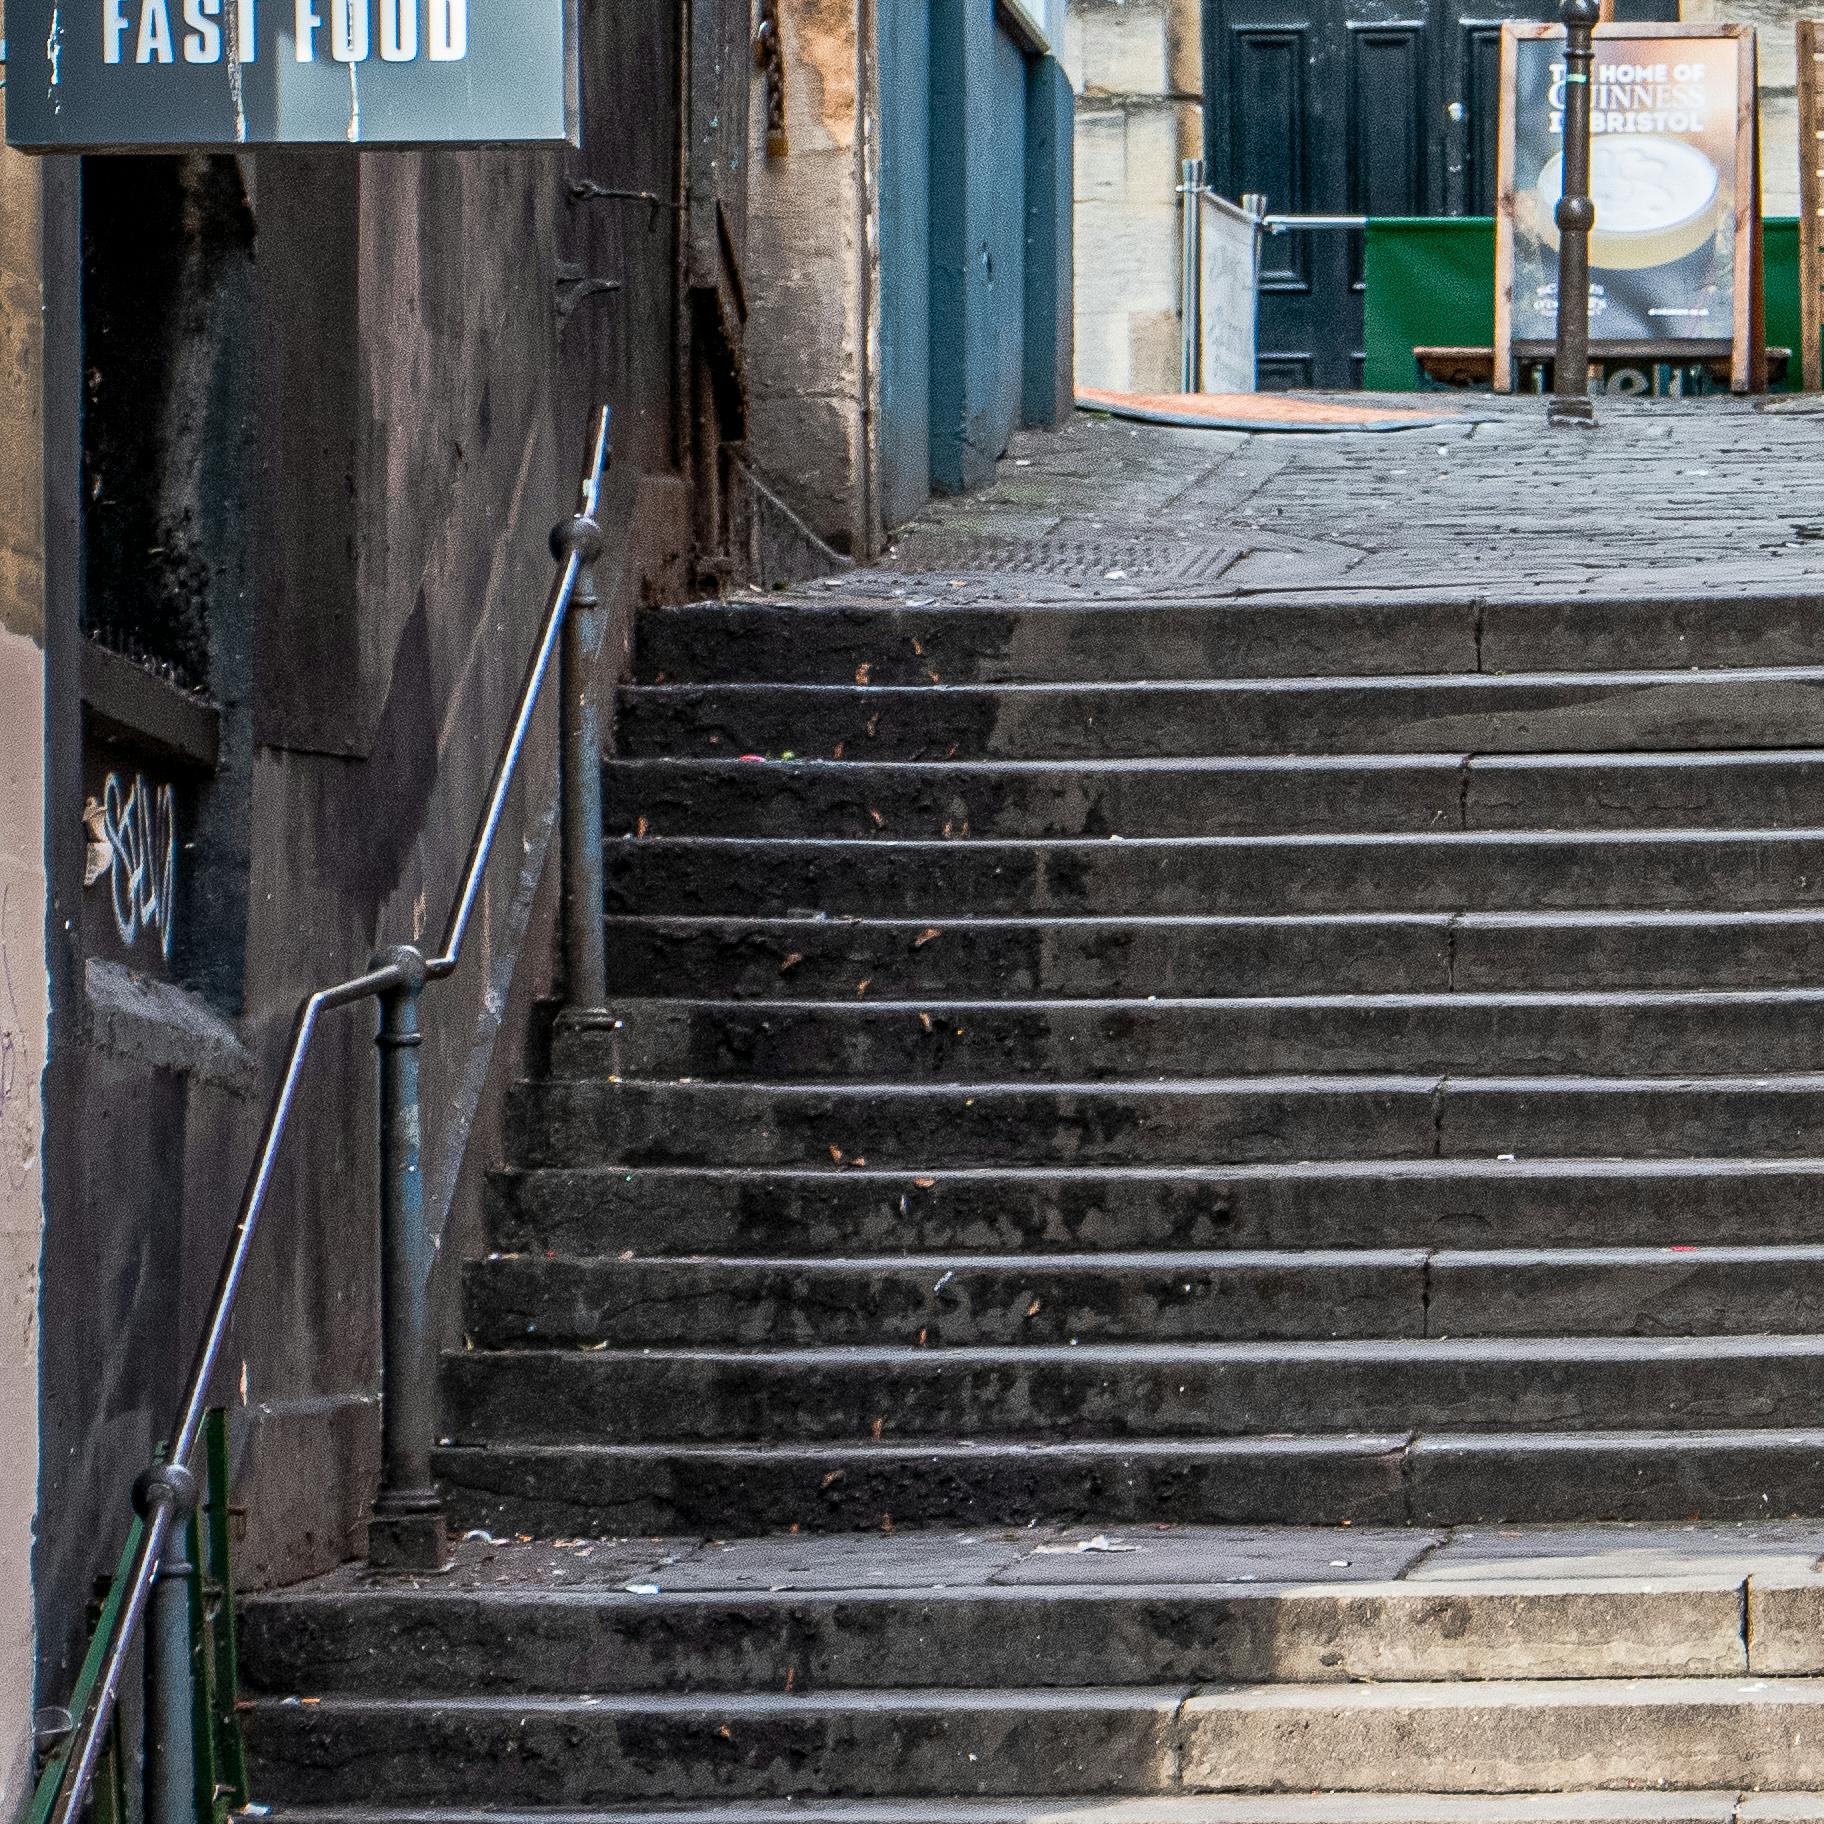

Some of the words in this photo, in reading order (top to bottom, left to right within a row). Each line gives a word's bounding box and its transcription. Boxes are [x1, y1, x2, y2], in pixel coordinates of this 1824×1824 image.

[1599, 64, 1667, 83] HOME
[1673, 64, 1705, 82] OF
[1548, 81, 1704, 109] GINNESS
[1592, 111, 1704, 133] BRISTOL
